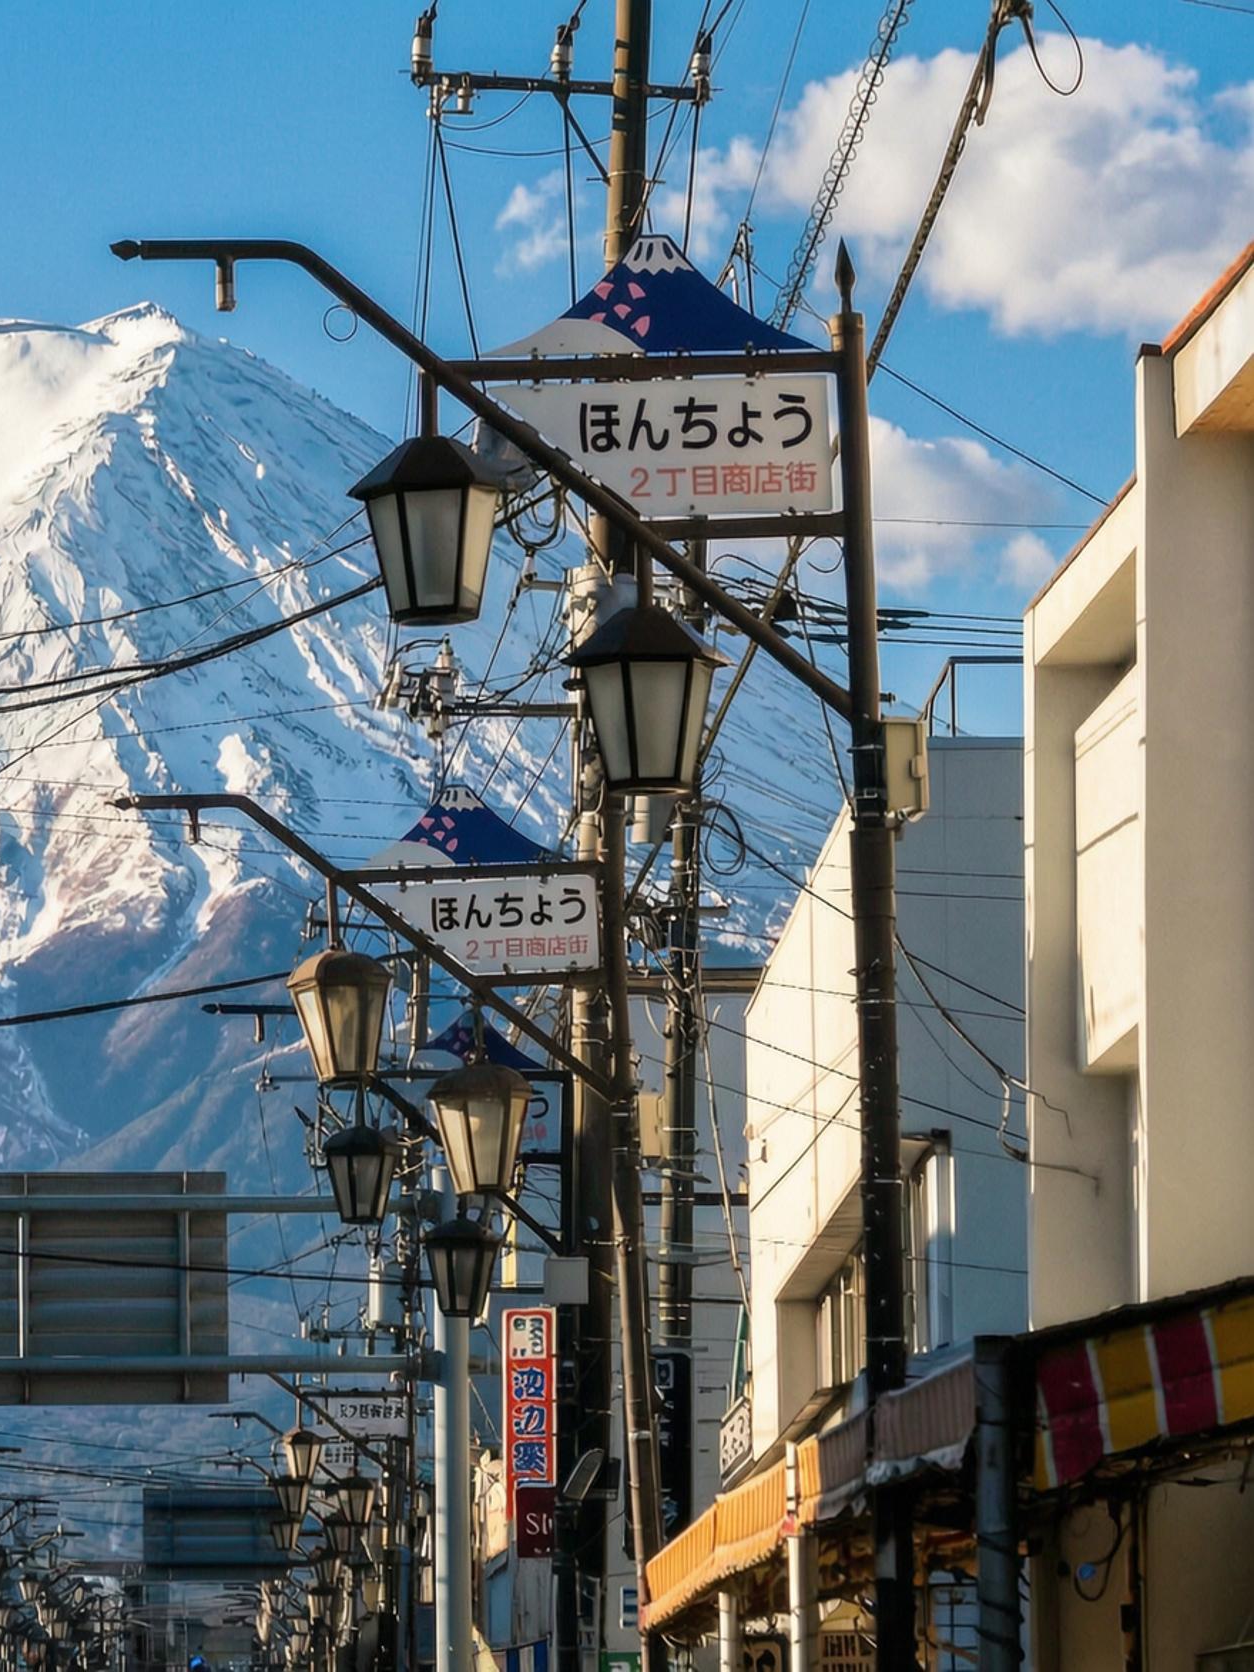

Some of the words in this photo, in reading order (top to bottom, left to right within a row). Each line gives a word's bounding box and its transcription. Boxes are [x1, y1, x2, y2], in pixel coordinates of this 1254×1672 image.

[579, 394, 813, 453] ほんちょう
[630, 461, 817, 498] 2丁目商店街
[431, 888, 587, 932] ほんちょう
